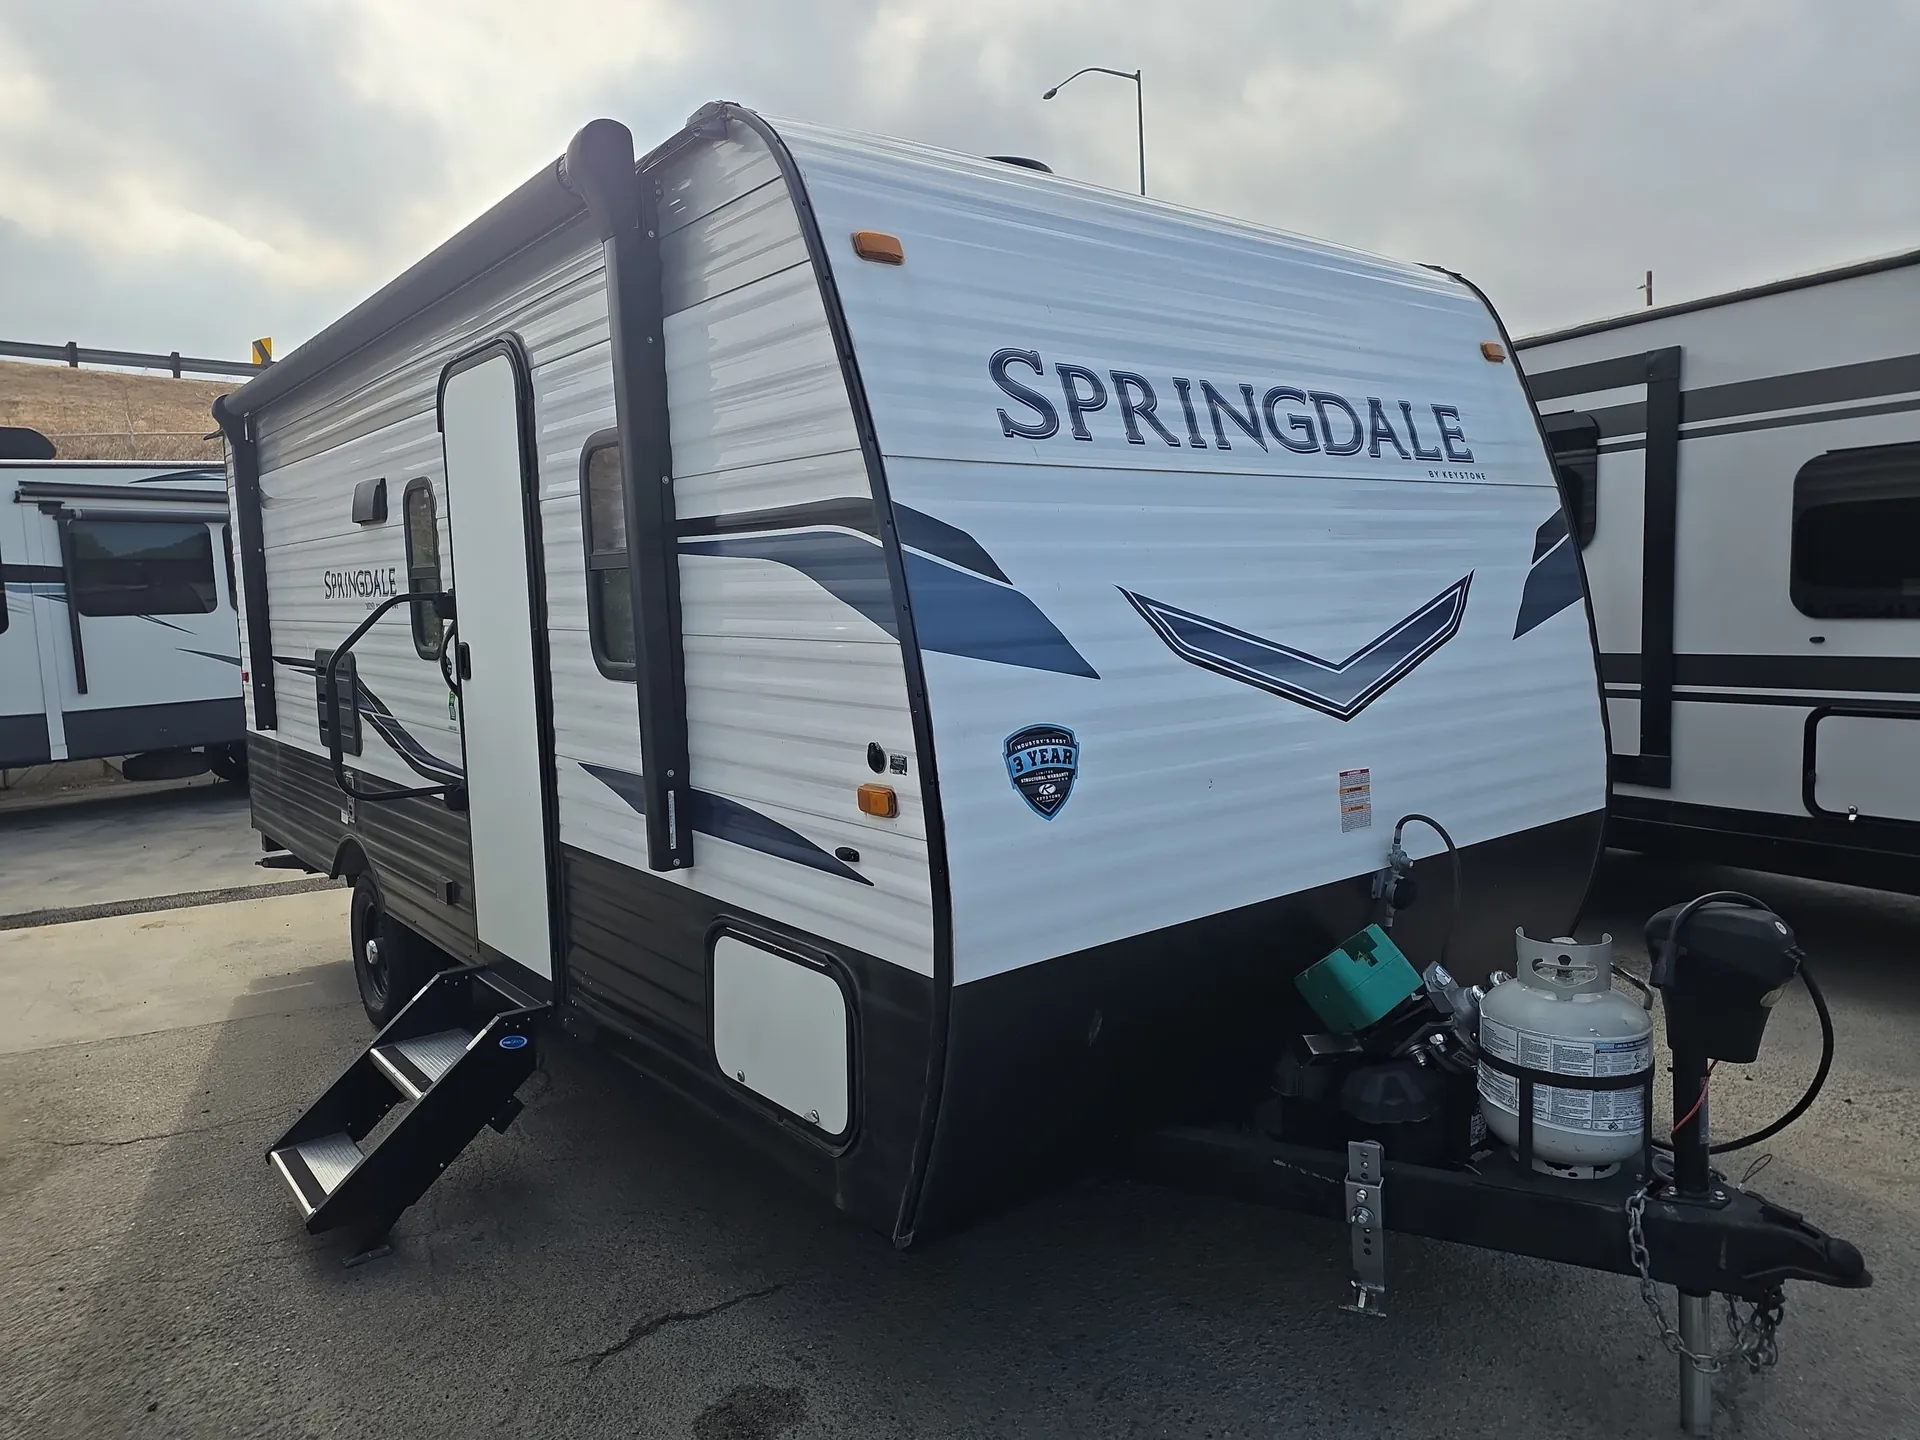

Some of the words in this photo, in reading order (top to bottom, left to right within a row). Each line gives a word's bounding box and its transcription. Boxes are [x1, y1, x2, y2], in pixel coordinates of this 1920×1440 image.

[988, 347, 1475, 463] SPRINGDALE
[1428, 470, 1439, 478] BY
[1442, 471, 1487, 480] KEYSTONE
[324, 567, 397, 599] SPRINGDALE
[1014, 739, 1050, 750] INDUSTRY'S
[1013, 756, 1024, 773] 3
[1027, 748, 1072, 766] YEAR
